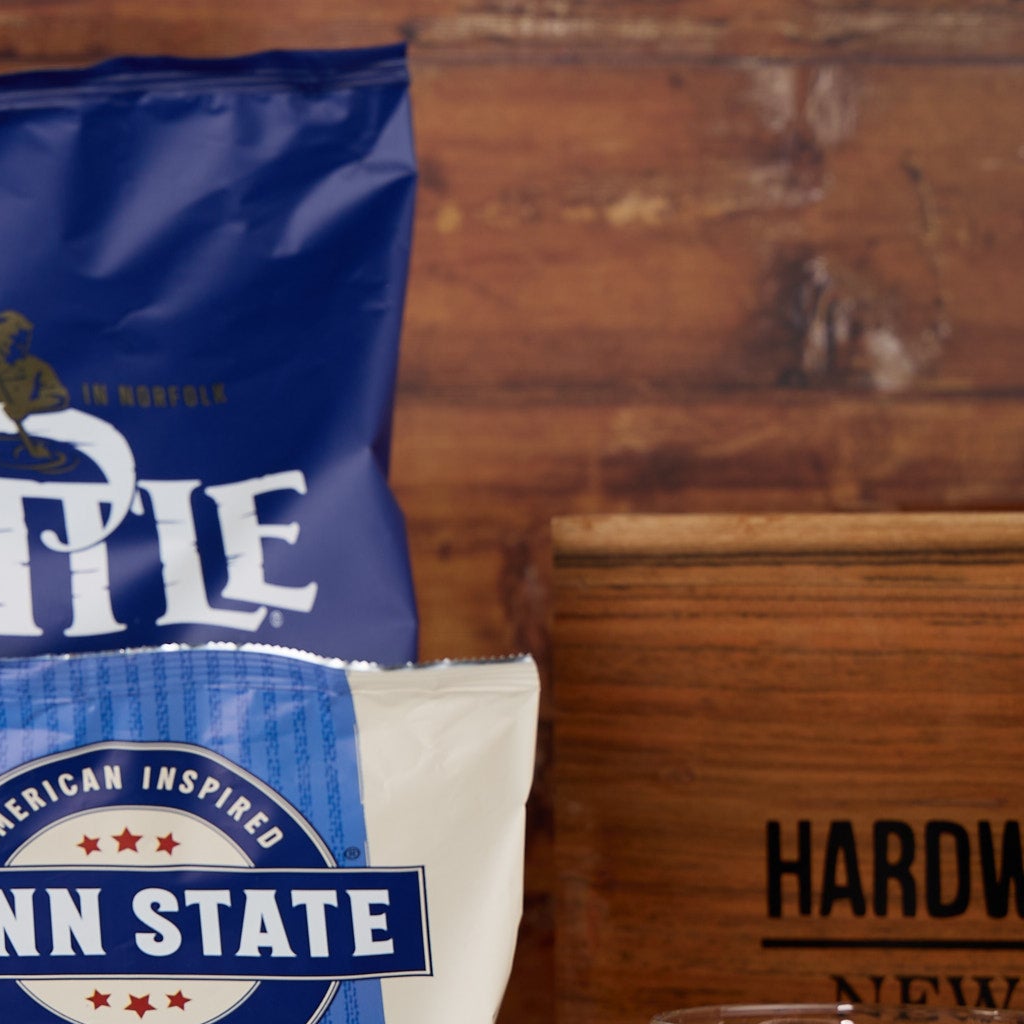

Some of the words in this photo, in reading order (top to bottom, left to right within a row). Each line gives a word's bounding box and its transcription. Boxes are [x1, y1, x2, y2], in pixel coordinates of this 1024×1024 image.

[81, 382, 108, 406] IN
[117, 383, 227, 409] NORFOLK
[143, 766, 284, 850] INSPIRED
[766, 819, 1024, 919] HARDW
[132, 888, 394, 957] STATE
